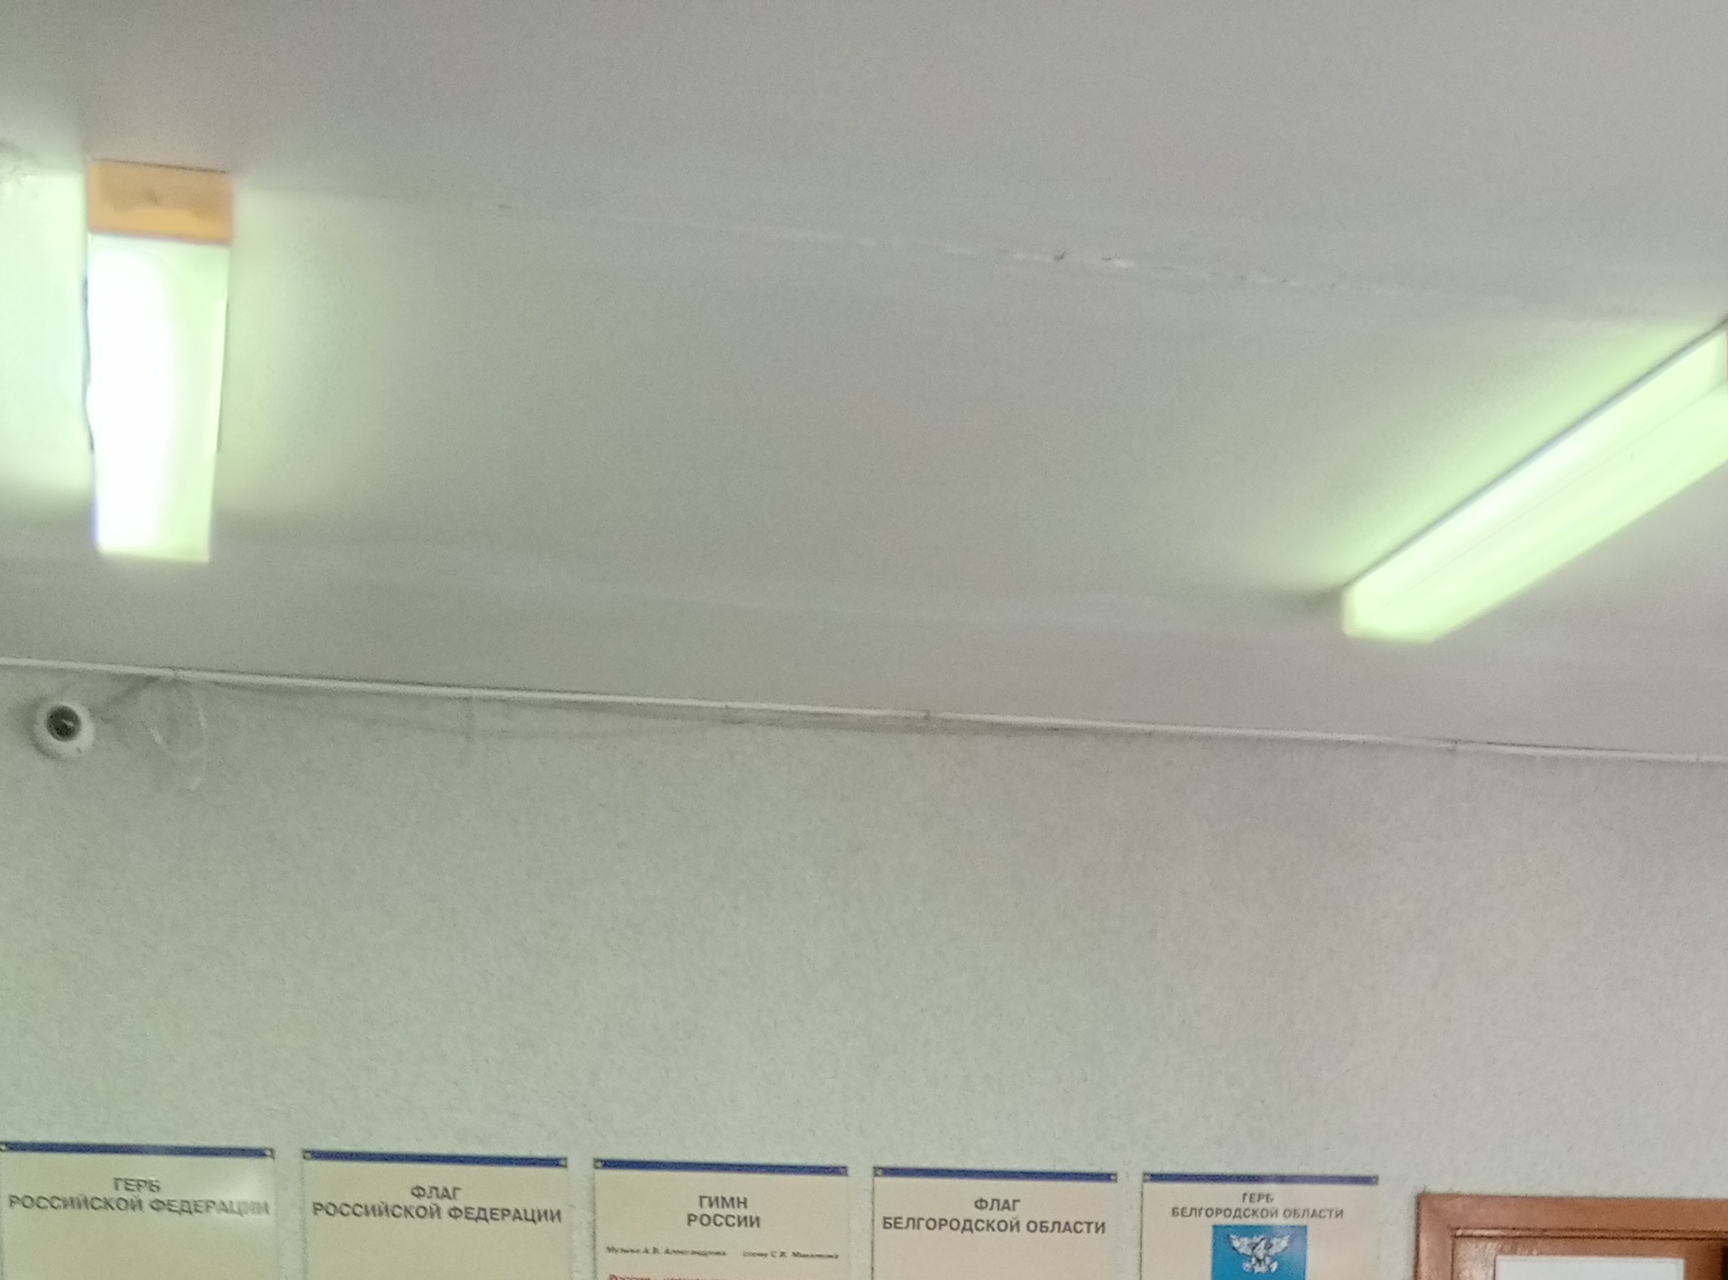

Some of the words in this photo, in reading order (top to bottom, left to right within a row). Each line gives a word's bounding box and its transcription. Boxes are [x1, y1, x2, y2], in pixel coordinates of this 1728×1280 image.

[113, 1177, 161, 1192] ГЕРБ
[410, 1184, 462, 1201] ФЛАГ
[1242, 1192, 1274, 1204] ГЕРБ
[8, 1193, 143, 1212] РОССИЙСКОЙ
[150, 1197, 270, 1216] ФЕДЕРАЦИИ
[698, 1195, 748, 1210] ГИМН
[974, 1198, 1020, 1213] ФЛАГ
[312, 1199, 441, 1220] РОССИЙСКОЙ
[448, 1206, 562, 1225] ФЕДЕРАЦИИ
[1171, 1204, 1278, 1219] БЕЛГОРОДСКОЙ
[1282, 1207, 1344, 1220] ОБЛАСТИ
[687, 1213, 761, 1228] РОССИИ
[882, 1213, 1020, 1234] БЕЛГОРОДСКОЙ
[1026, 1219, 1106, 1235] ОБЛАСТИ
